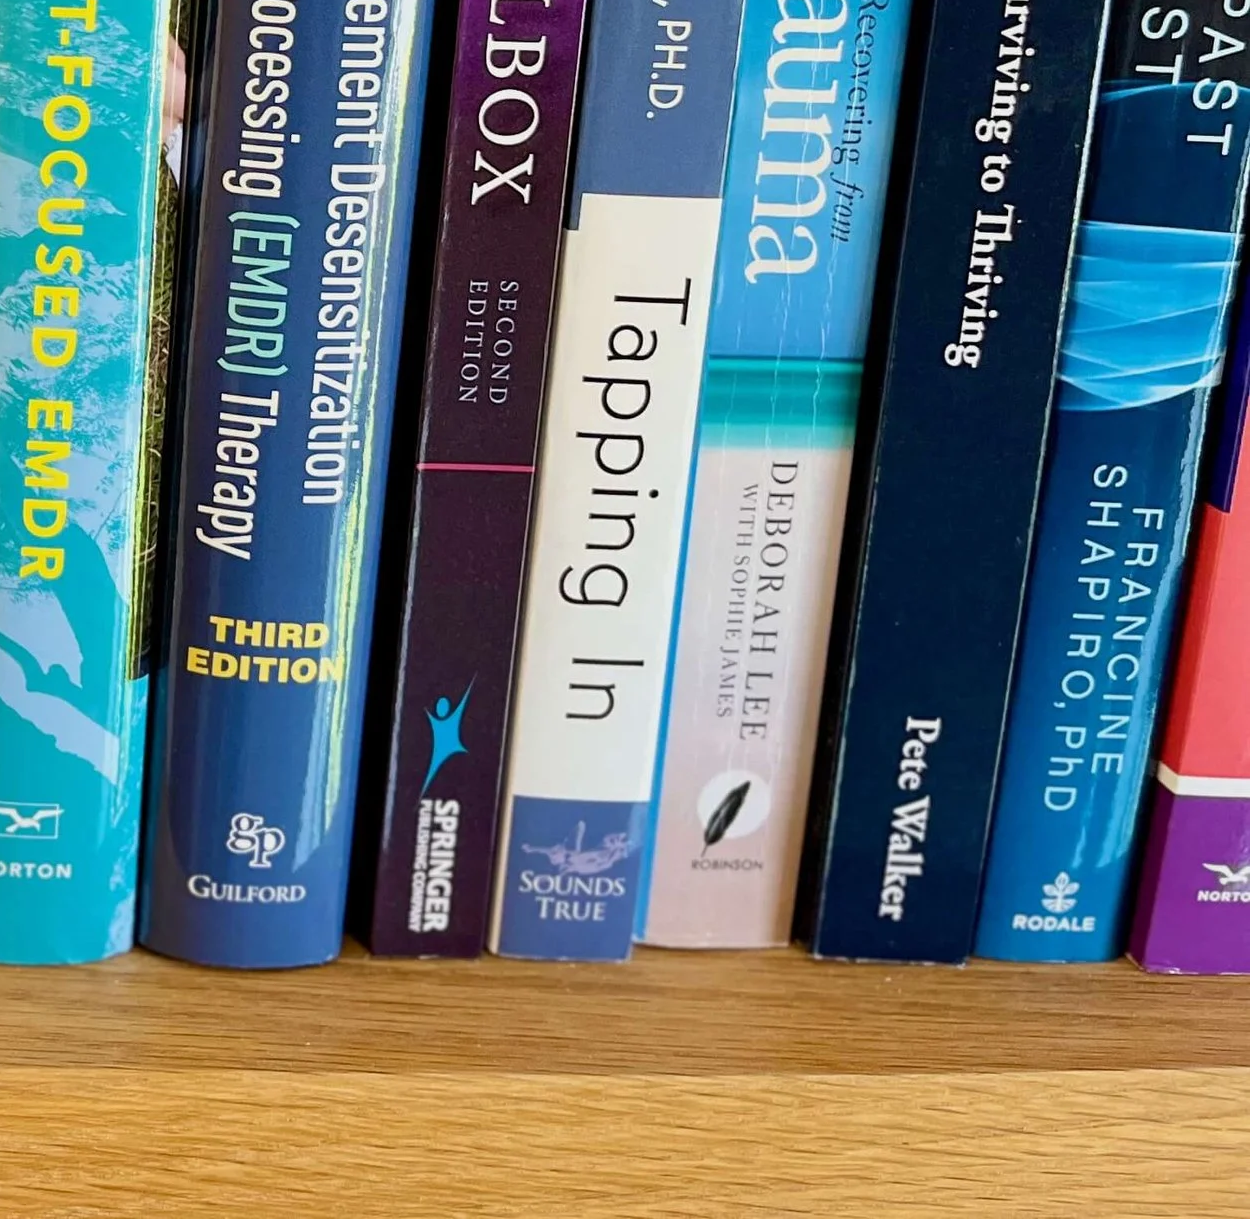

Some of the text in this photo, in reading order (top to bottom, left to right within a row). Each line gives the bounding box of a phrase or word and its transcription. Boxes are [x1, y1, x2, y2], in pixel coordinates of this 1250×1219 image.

[647, 21, 691, 118] PH.D.
[830, 172, 864, 242] from
[981, 154, 1011, 192] to
[217, 212, 300, 376] (EMDR)
[302, 163, 386, 505] Desensitization
[459, 280, 488, 402] EDITION
[490, 281, 519, 403] SECOND
[945, 204, 1014, 368] Thriving
[20, 399, 73, 579] EMDR
[196, 391, 279, 560] Therapy
[559, 278, 691, 719] Tapping In
[186, 646, 344, 684] EDITION
[209, 615, 329, 648] THIRD
[717, 484, 758, 717] WITH SOPHIE JAMES
[740, 460, 799, 742] DEBORAH LEE
[1045, 465, 1127, 811] SHAPIRO, PhD
[1090, 506, 1164, 777] FRANCINE
[408, 799, 433, 932] PUBLISHING COMPANY
[423, 800, 459, 931] SPRINGER
[692, 860, 763, 870] ROBINSON
[879, 716, 941, 920] Pete Walker
[1013, 915, 1095, 931] RODALE
[1198, 891, 1250, 902] NORTO
